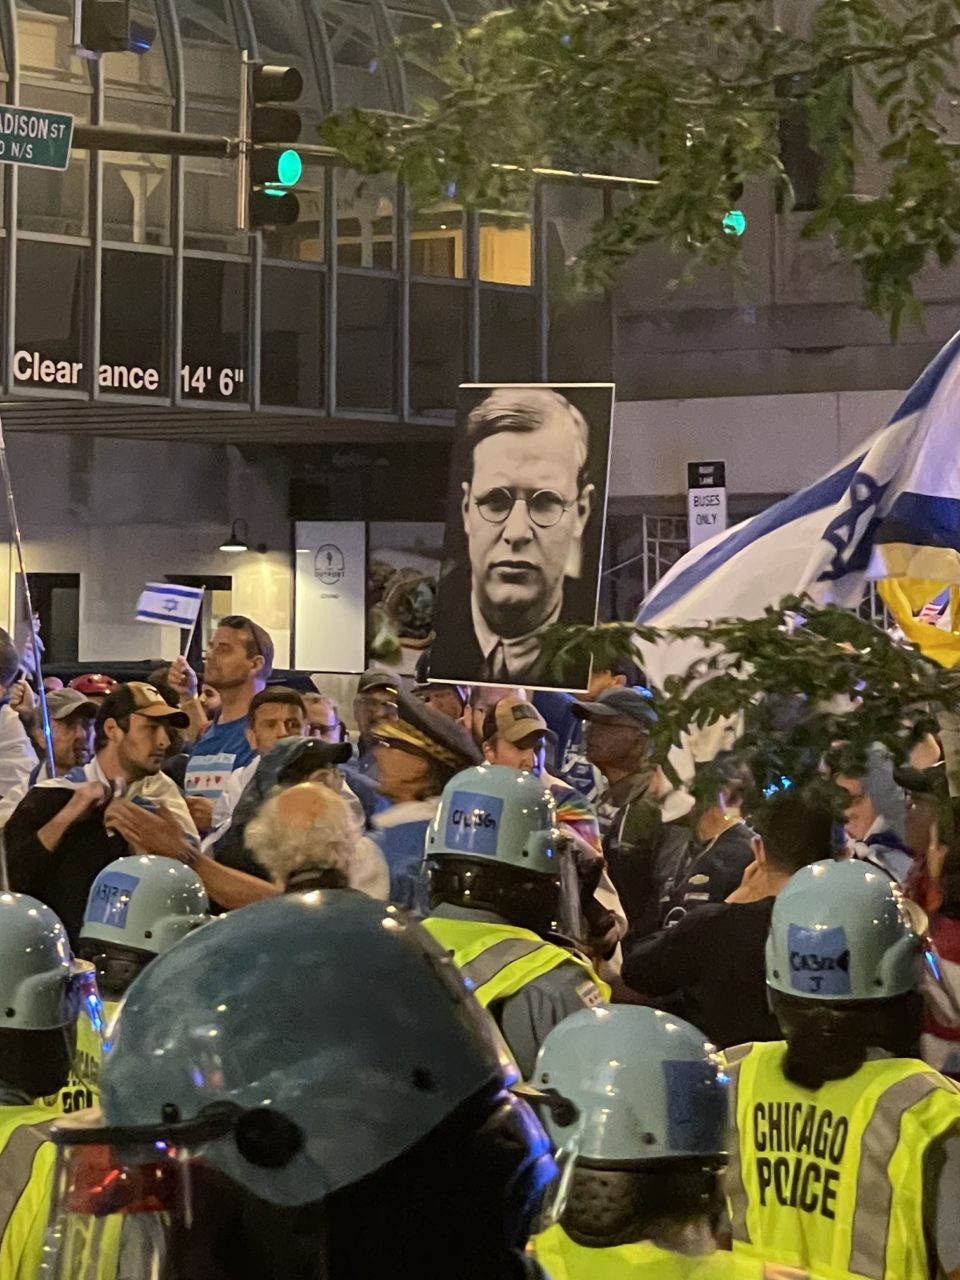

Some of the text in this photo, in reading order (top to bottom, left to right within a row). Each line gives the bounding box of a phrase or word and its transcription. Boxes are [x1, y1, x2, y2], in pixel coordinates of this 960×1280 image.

[50, 123, 66, 139] ST
[11, 142, 33, 159] N/S
[181, 365, 212, 394] 14'
[219, 368, 244, 396] 6"
[693, 494, 720, 508] BUSES
[696, 513, 717, 526] ONLY
[753, 1102, 849, 1165] CHICAGO
